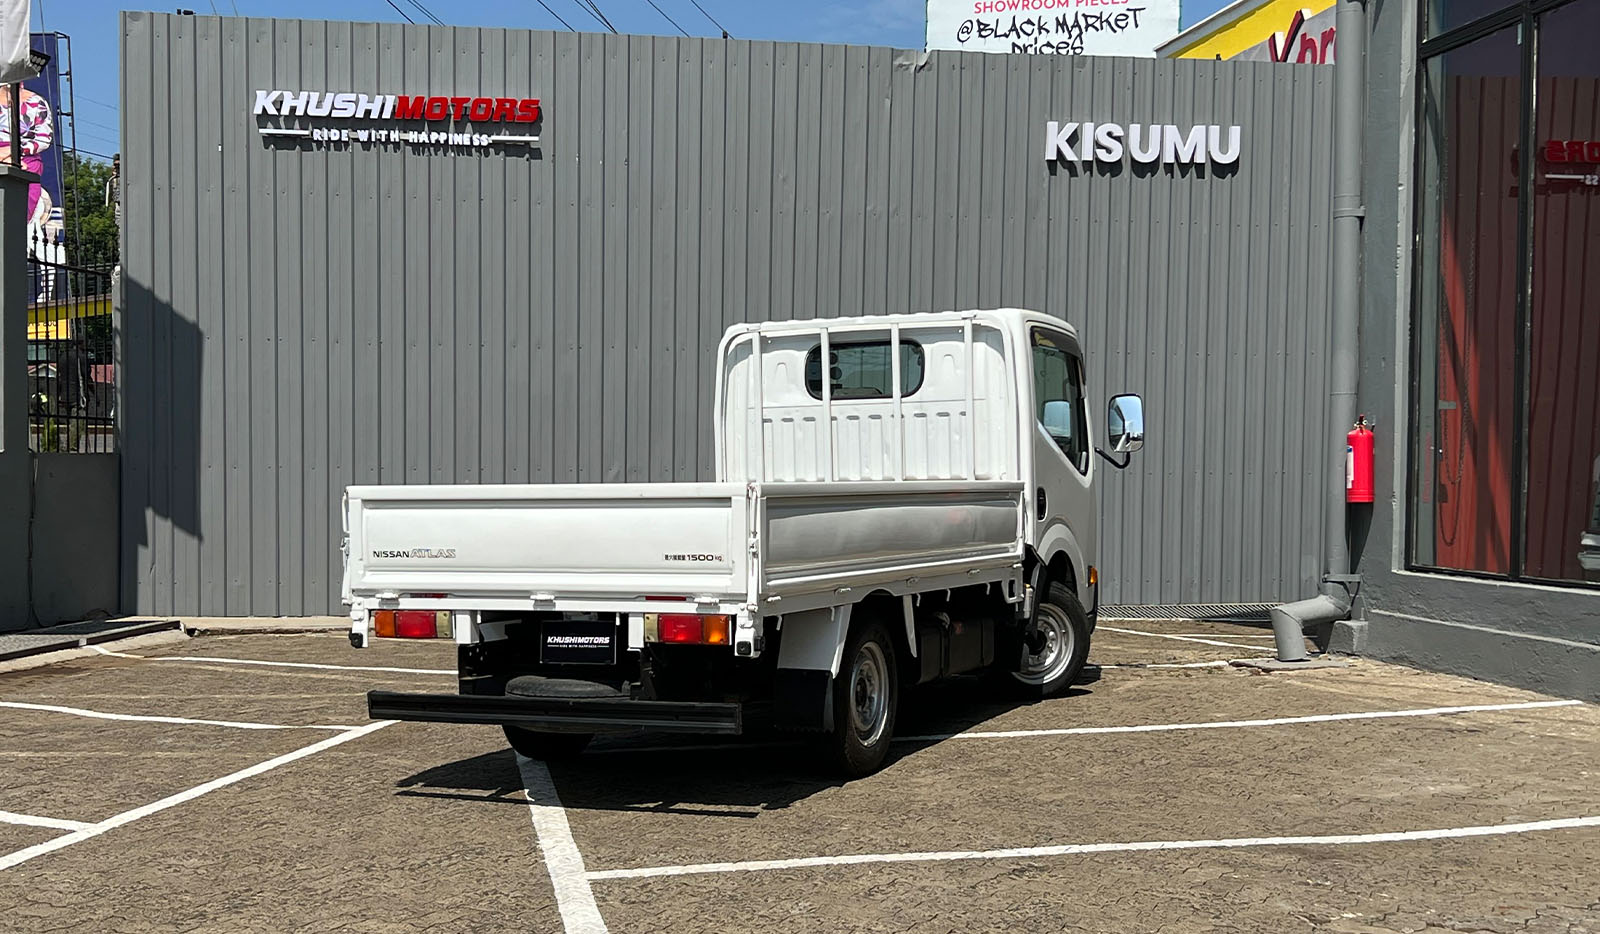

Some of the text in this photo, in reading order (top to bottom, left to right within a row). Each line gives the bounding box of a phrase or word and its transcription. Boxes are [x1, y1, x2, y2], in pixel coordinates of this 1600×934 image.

[974, 0, 1069, 14] SHOWROOM
[312, 129, 490, 146] RIDE WITH HAPPINESS
[1045, 121, 1241, 164] KISUMU
[373, 548, 456, 559] NISSAN ATLAS
